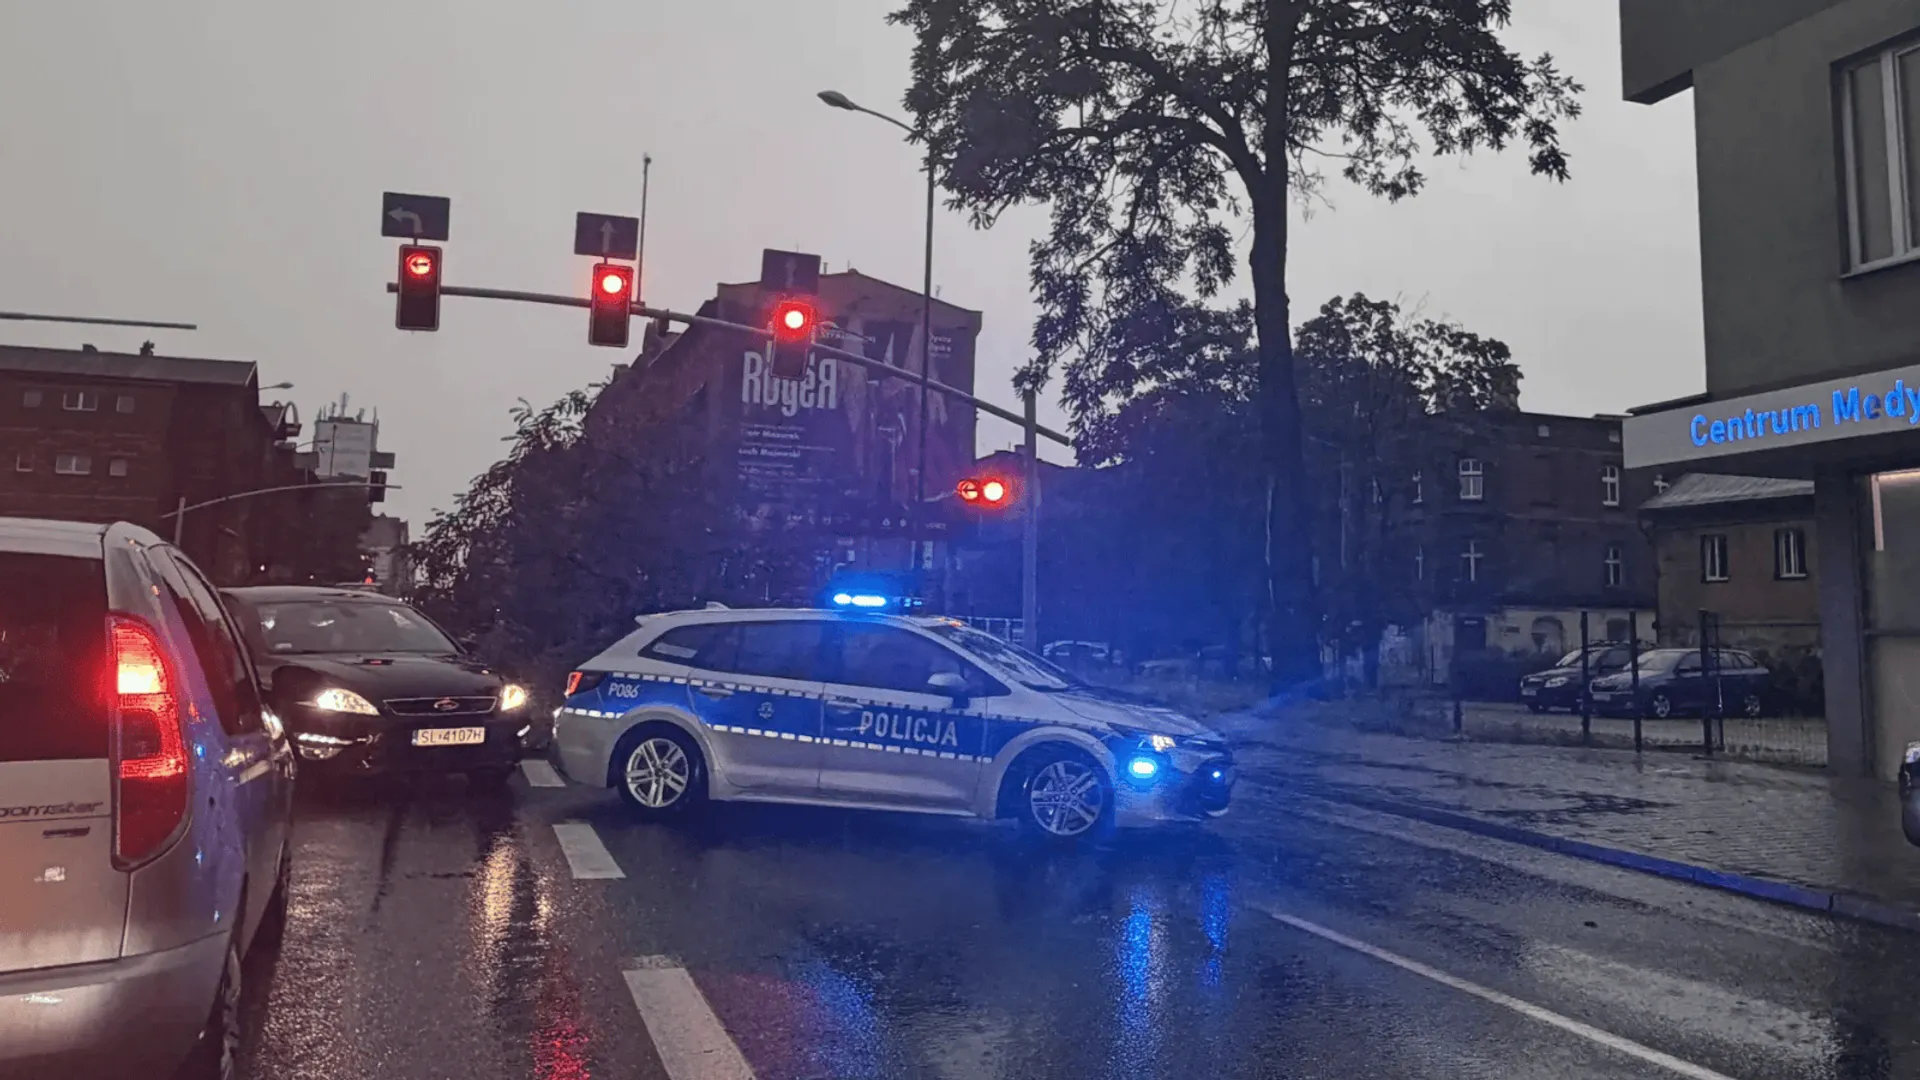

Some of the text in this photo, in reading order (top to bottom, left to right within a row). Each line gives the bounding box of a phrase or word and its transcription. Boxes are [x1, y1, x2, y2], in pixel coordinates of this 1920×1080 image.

[1690, 403, 1821, 447] Centrum
[421, 731, 437, 743] SL
[860, 711, 958, 747] POLICJA
